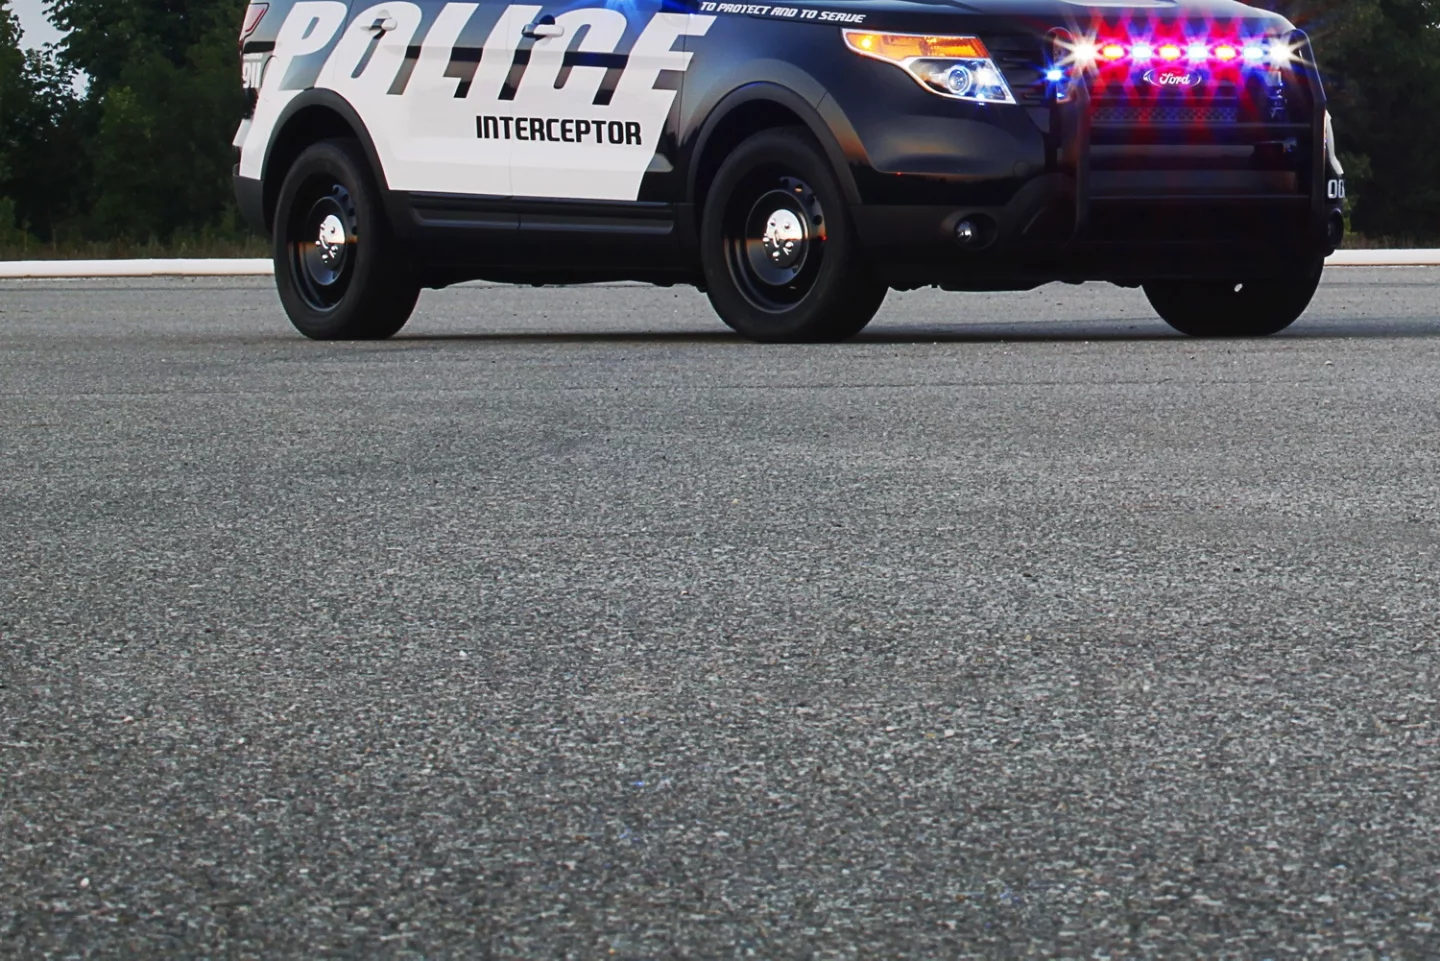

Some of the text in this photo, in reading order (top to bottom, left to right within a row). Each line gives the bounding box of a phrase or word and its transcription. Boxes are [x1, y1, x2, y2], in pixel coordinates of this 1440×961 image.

[700, 1, 866, 24] TO PROTECT AND TO SERVE
[264, 1, 718, 106] POLICE
[1159, 71, 1191, 86] Ford
[475, 115, 643, 146] INTERCEPTOR
